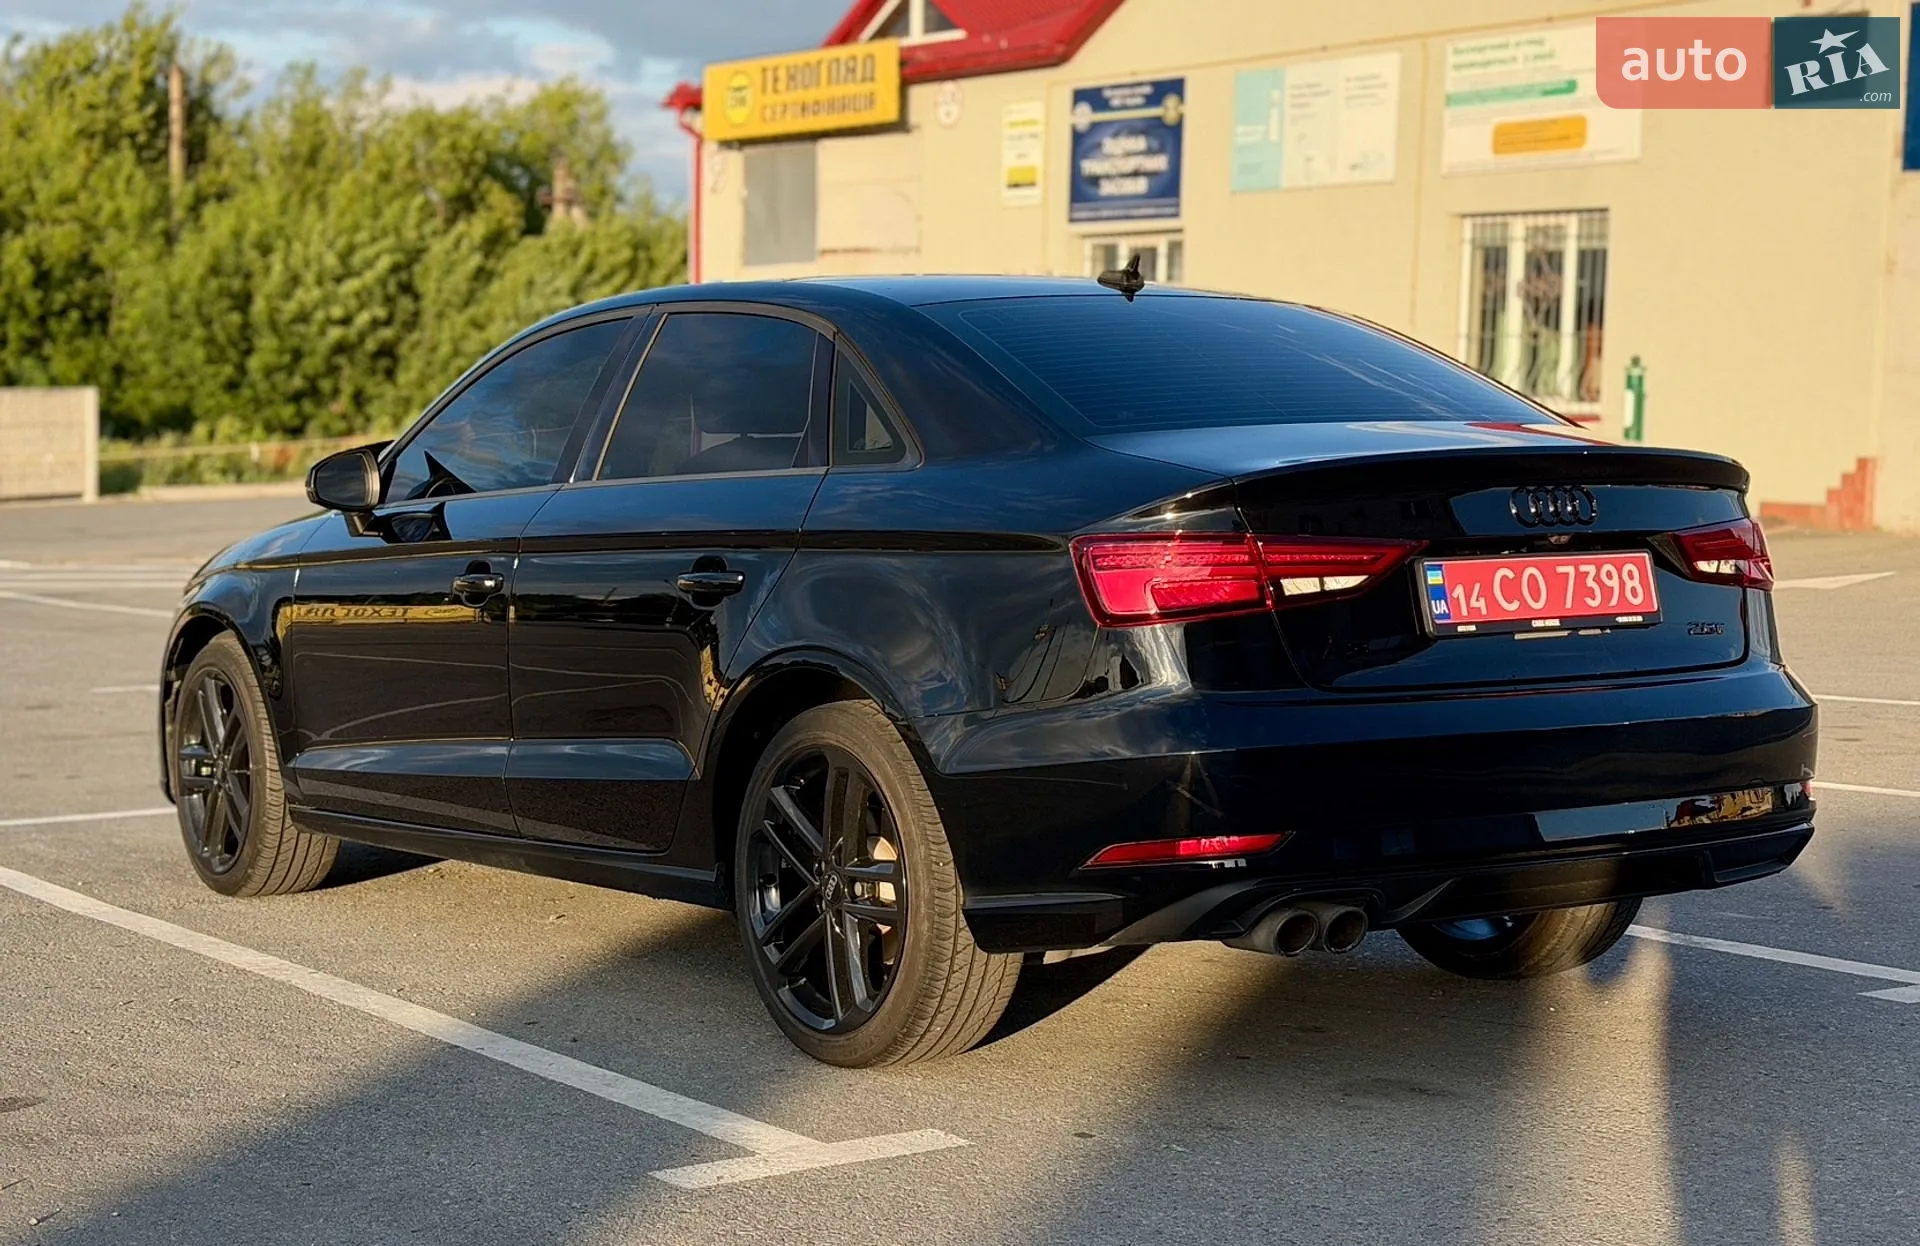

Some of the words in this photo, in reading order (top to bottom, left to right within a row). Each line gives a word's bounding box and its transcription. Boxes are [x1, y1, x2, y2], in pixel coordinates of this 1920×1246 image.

[1431, 599, 1449, 615] UA
[1451, 582, 1488, 617] 14
[1492, 566, 1548, 612] CO
[1555, 562, 1645, 609] 7398
